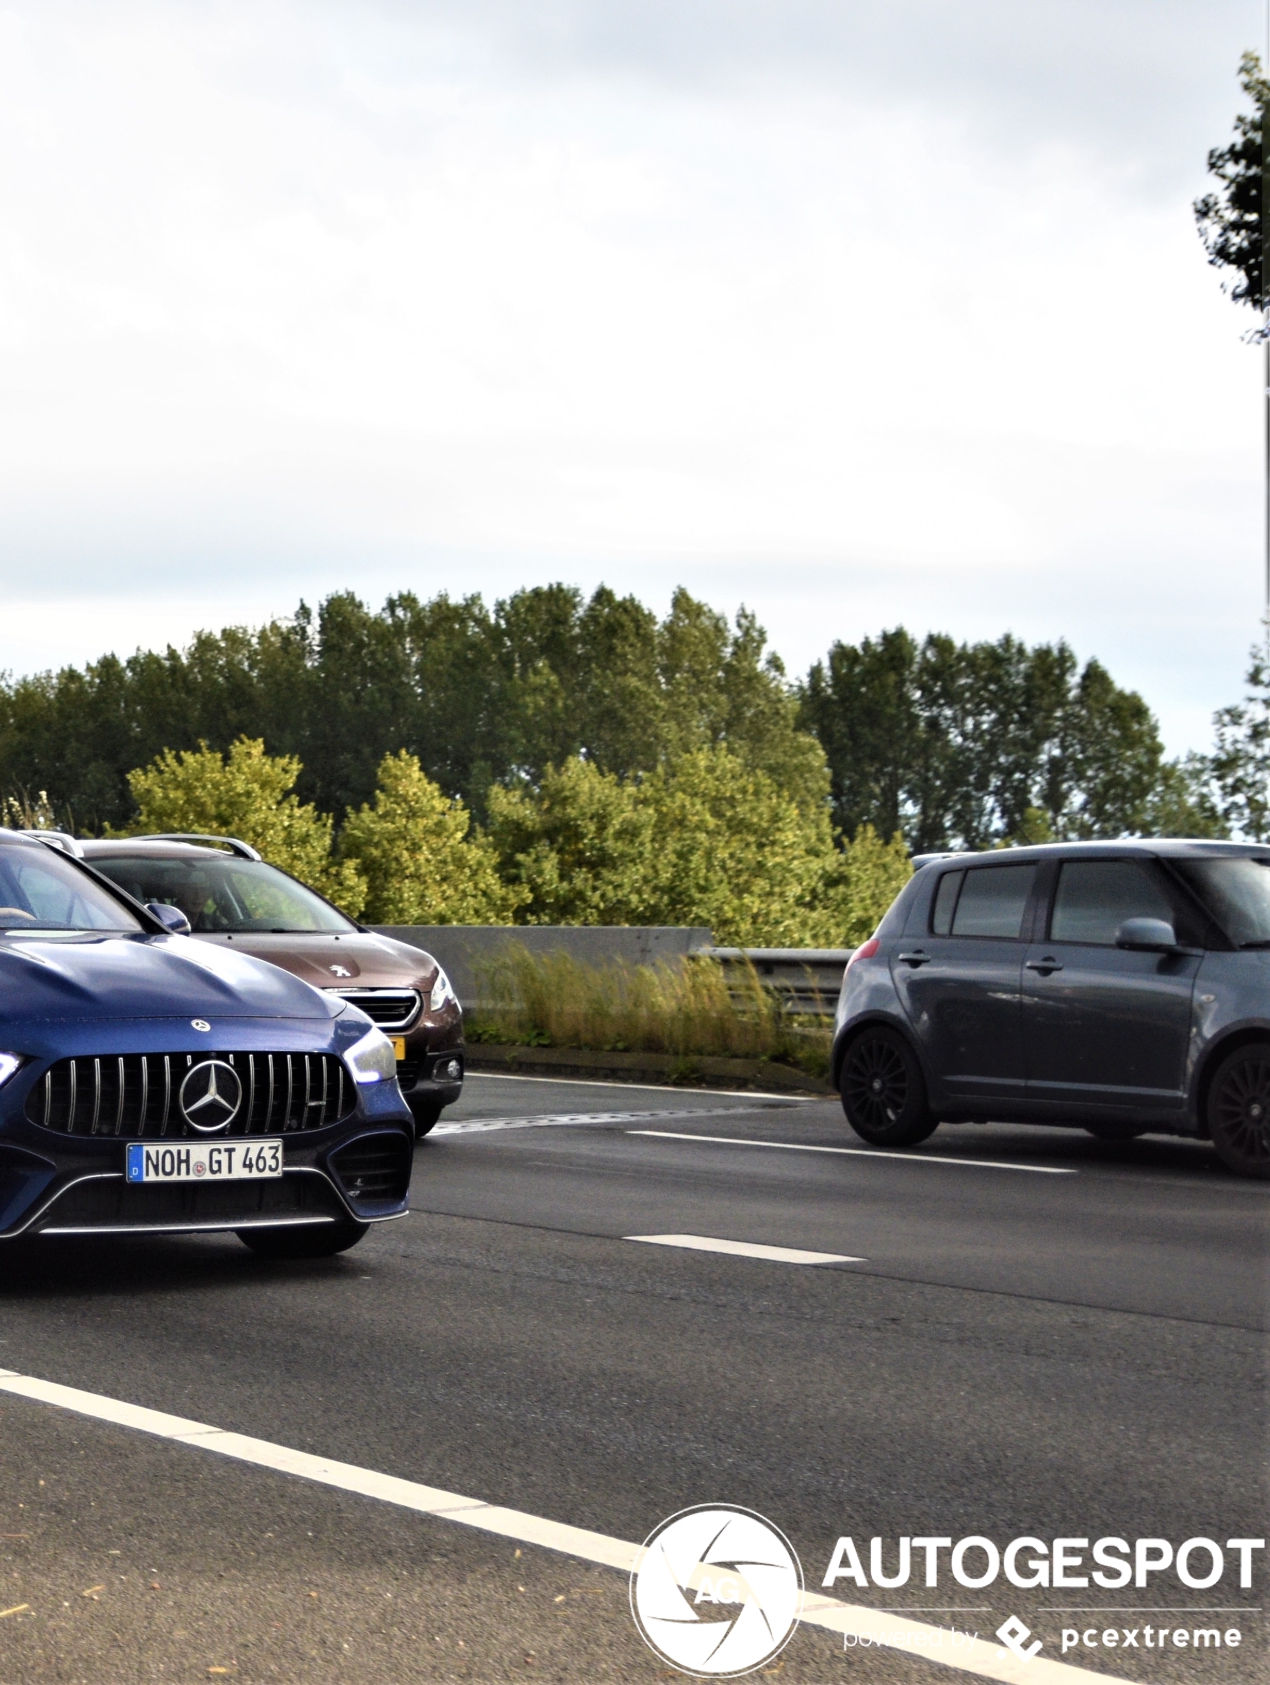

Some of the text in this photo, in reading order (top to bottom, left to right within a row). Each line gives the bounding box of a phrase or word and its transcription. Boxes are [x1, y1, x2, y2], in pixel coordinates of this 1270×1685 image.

[145, 1148, 191, 1177] NOH
[208, 1147, 236, 1175] GT
[242, 1145, 280, 1174] 463
